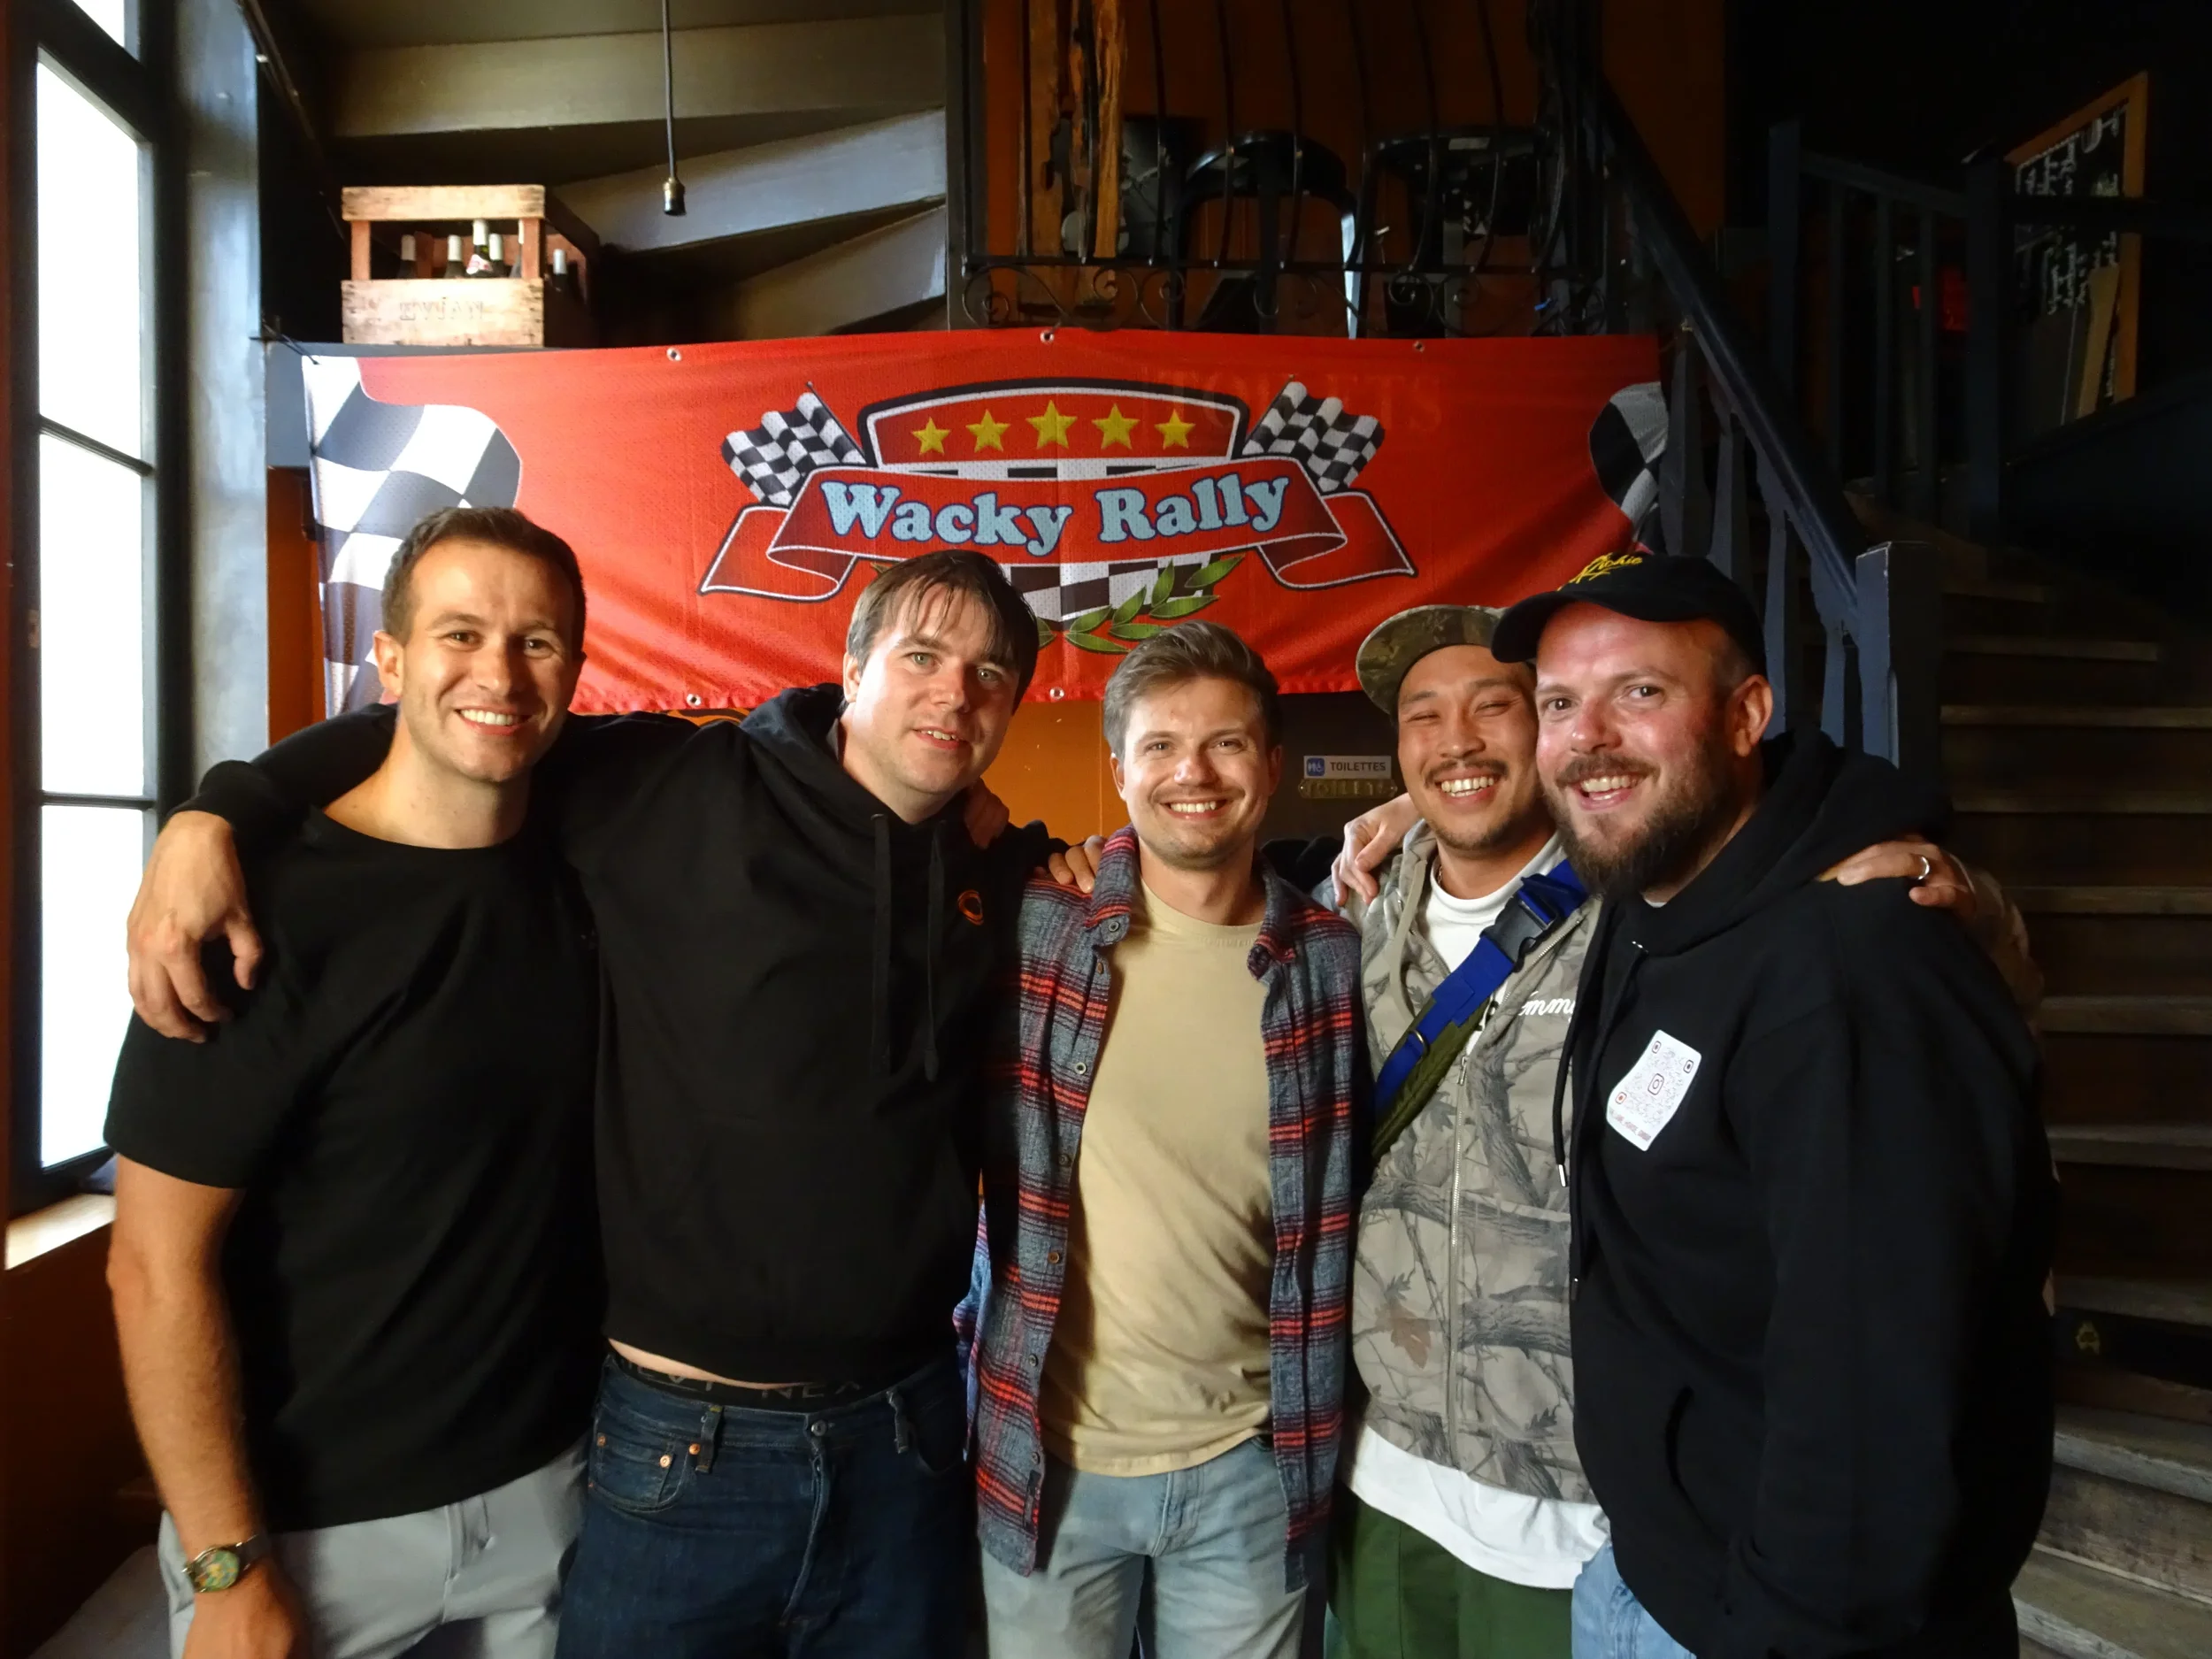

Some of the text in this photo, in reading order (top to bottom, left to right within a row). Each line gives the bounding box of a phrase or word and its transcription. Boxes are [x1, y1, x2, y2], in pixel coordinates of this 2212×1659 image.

[820, 472, 1290, 557] Wacky Rally
[1330, 761, 1386, 772] TOILETTES
